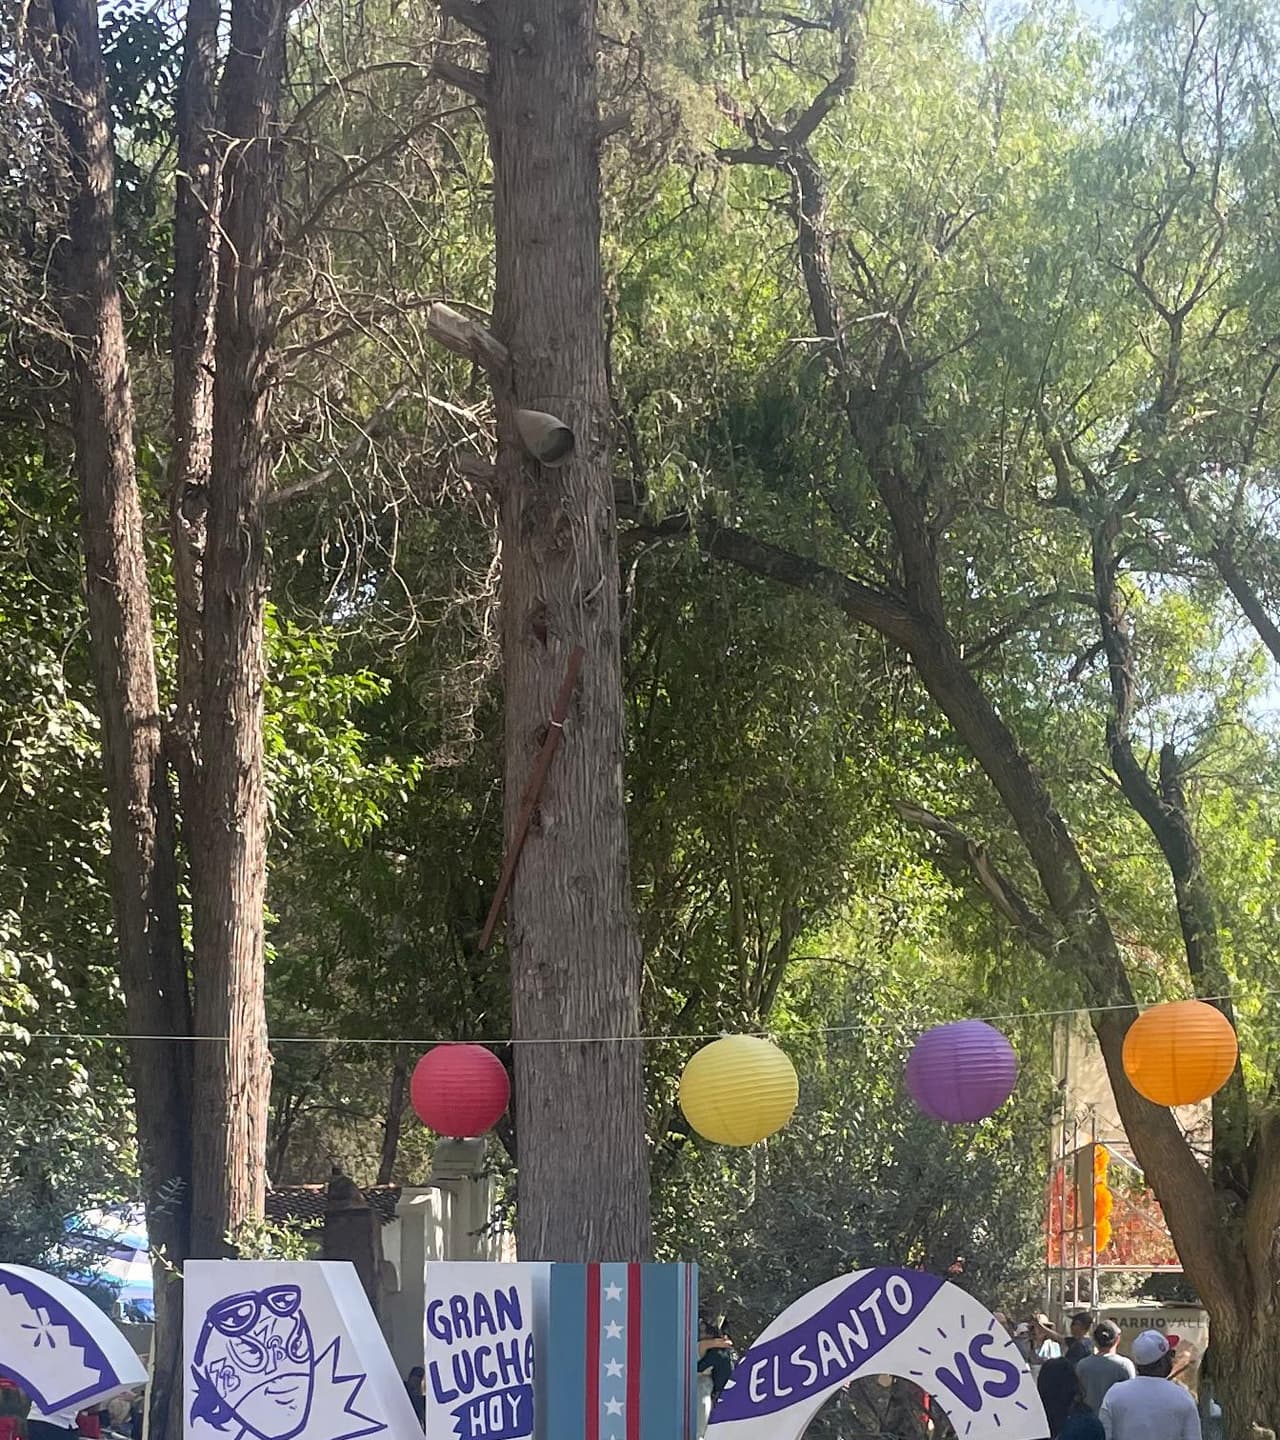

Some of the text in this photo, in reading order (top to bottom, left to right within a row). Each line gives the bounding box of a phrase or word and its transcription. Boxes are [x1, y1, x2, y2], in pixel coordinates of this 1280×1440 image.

[427, 1286, 522, 1345] GRAN
[429, 1333, 535, 1404] LUCHA
[935, 1333, 1020, 1412] VS
[470, 1393, 521, 1437] HOY
